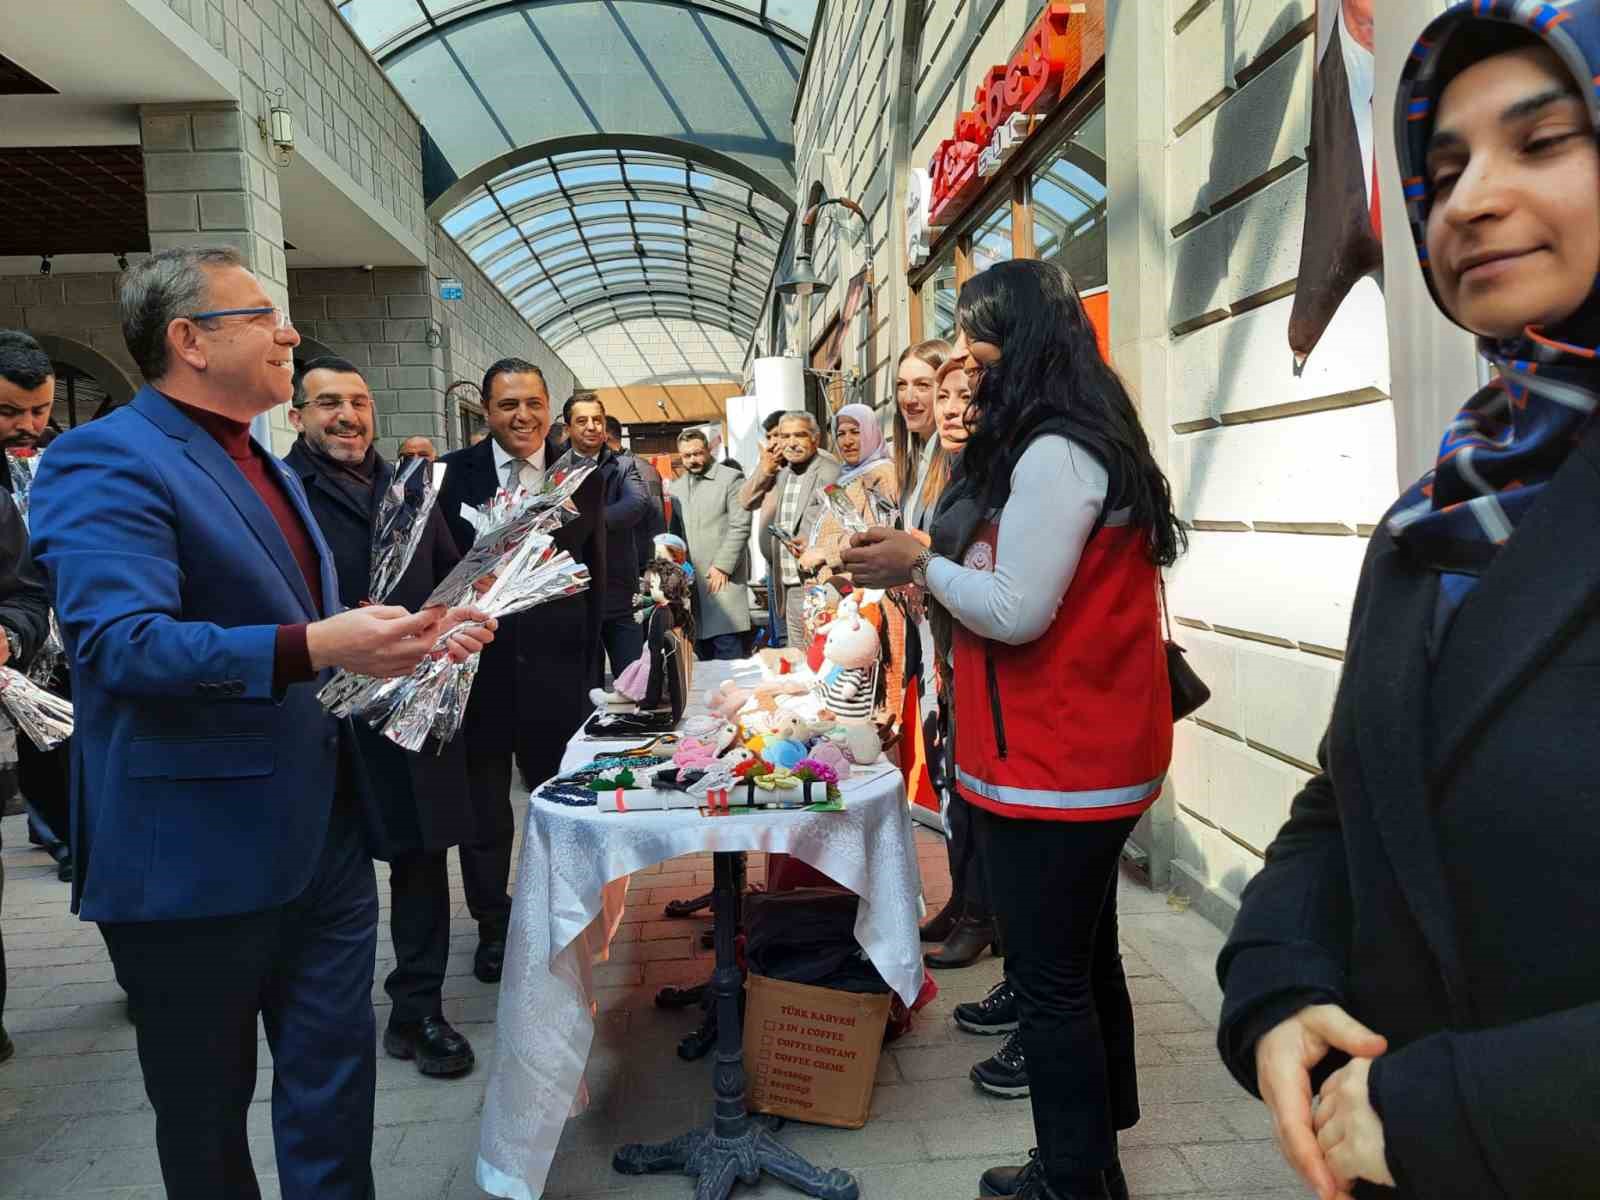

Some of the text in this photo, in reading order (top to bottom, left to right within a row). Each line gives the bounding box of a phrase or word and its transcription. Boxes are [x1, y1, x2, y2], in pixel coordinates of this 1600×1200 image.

[780, 1005, 808, 1018] TÜRK
[807, 1028, 845, 1041] COFFEE
[777, 1038, 815, 1052] COFFEE
[775, 1052, 810, 1066] COFFEE
